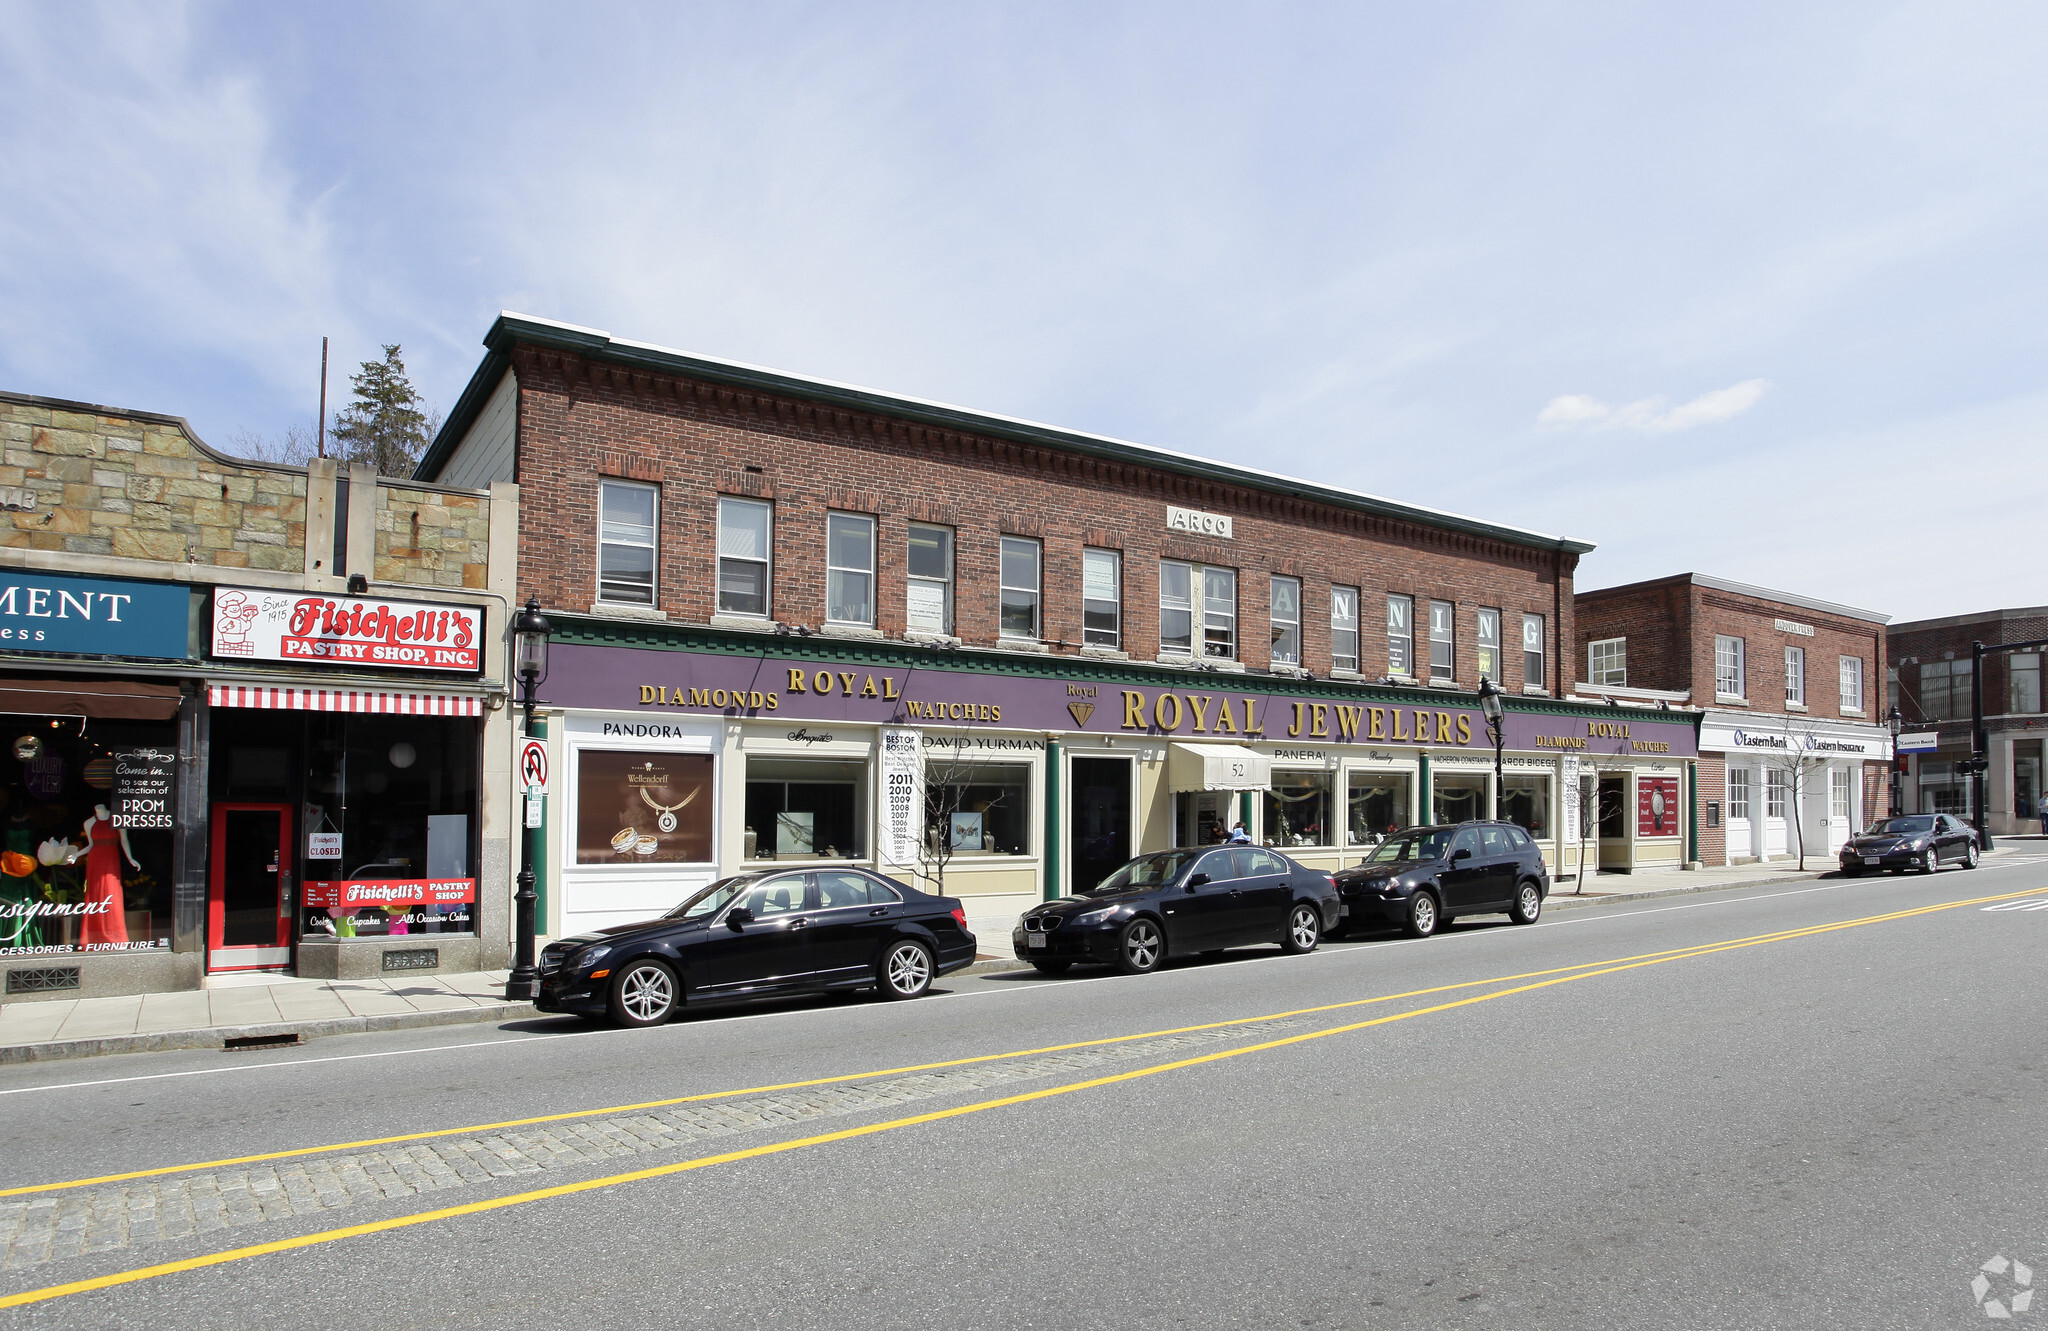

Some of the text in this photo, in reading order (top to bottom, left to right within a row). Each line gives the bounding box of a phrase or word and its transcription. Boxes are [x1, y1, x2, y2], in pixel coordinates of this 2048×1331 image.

[1172, 510, 1225, 535] ARCO
[261, 596, 290, 612] Since
[268, 609, 288, 623] 1915
[290, 598, 473, 649] Fisichelli's
[286, 640, 474, 665] PASTRY SHOP, INC.
[788, 668, 899, 699] ROYAL
[640, 685, 778, 710] DIAMONDS
[1067, 684, 1098, 698] Royal
[906, 701, 1001, 721] WATCHES
[1121, 691, 1471, 744] ROYAL JEWELERS
[604, 723, 682, 739] PANDORA
[1588, 722, 1630, 738] ROYAL
[886, 735, 903, 744] BEST
[922, 736, 1045, 750] DAVID YURMAN
[1536, 735, 1587, 748] DIAMONDS
[1632, 741, 1669, 752] WATCHES
[1743, 733, 1788, 749] Eastern Bank
[1814, 740, 1836, 752] Eastern
[1274, 750, 1326, 760] PANERAI
[1434, 755, 1460, 764] VACHERON
[116, 763, 148, 776] Come
[1496, 758, 1557, 768] ARCO BICEGO
[1232, 763, 1244, 778] 52
[628, 774, 669, 783] Wellendorff
[889, 774, 912, 784] 2011
[889, 786, 912, 795] 2010
[122, 800, 164, 812] PROM
[112, 814, 173, 828] DRESSES
[310, 848, 341, 856] CLOSED
[346, 884, 424, 901] Fisichelli's
[429, 882, 470, 891] PASTRY
[436, 892, 464, 900] SHOP
[0, 894, 114, 942] signment
[347, 915, 380, 927] Cupcakes
[396, 915, 414, 924] All
[417, 913, 447, 923] Occasion
[449, 912, 470, 922] Cakes
[85, 940, 156, 952] FURNITURE
